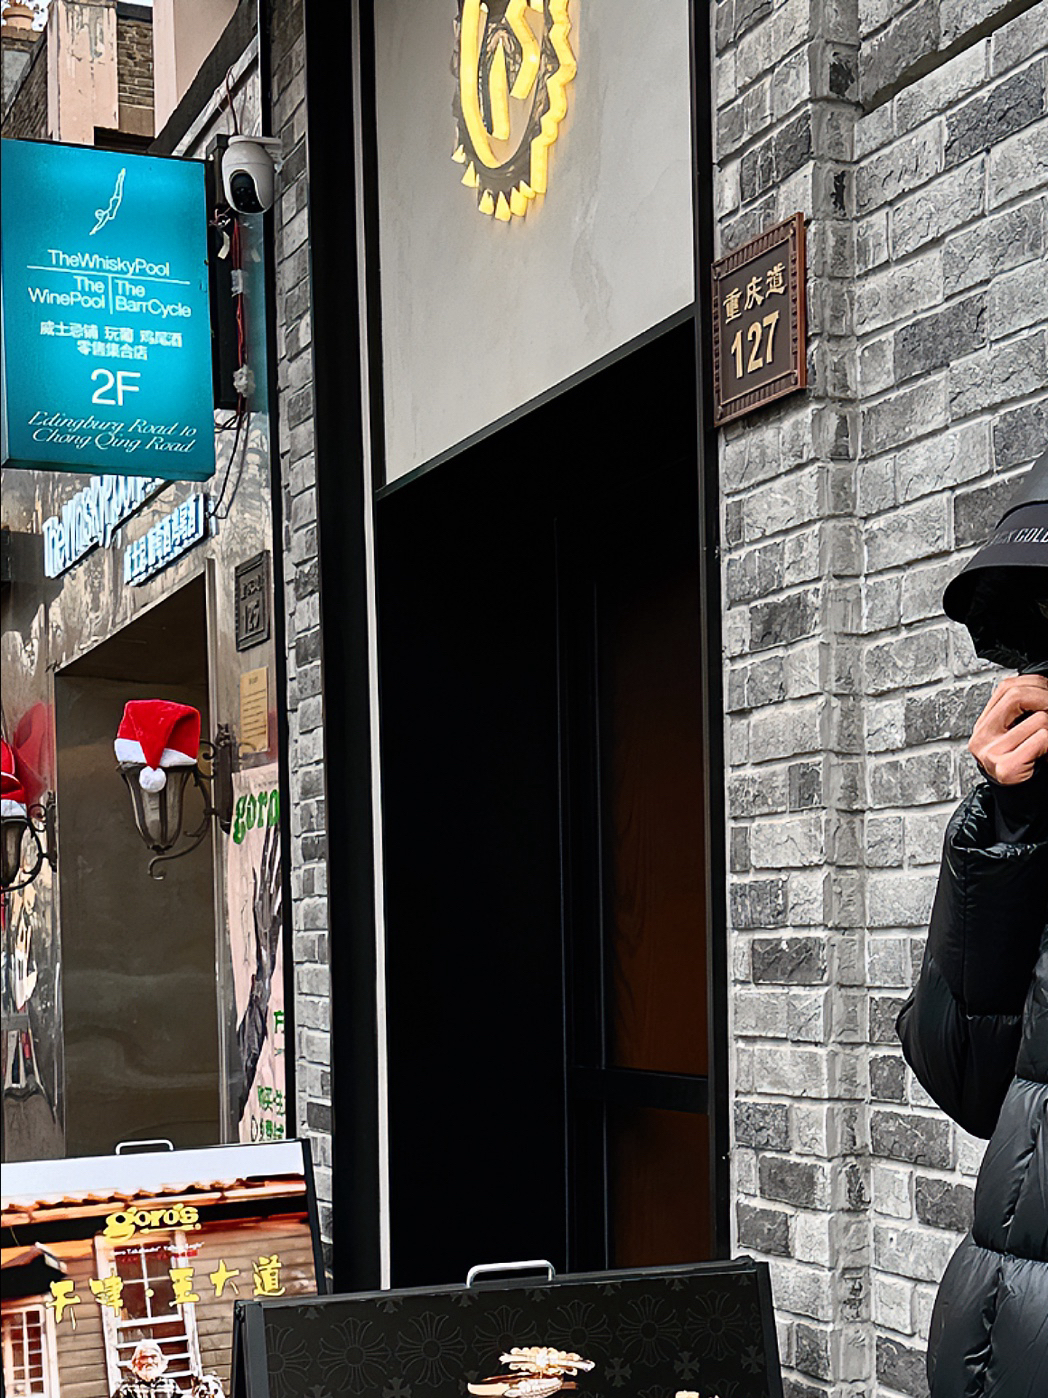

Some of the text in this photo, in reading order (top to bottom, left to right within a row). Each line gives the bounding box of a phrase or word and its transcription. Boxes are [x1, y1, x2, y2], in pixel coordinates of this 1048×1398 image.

[48, 249, 170, 277] TheWhiskyPool
[28, 287, 106, 309] WinePool
[73, 276, 105, 294] The
[114, 279, 146, 297] The
[722, 262, 787, 325] 重庆道
[730, 310, 780, 379] 127
[90, 368, 141, 406] 2F
[127, 417, 180, 435] Road
[32, 427, 197, 453] Chong Qing Road
[103, 1203, 200, 1243] goro's
